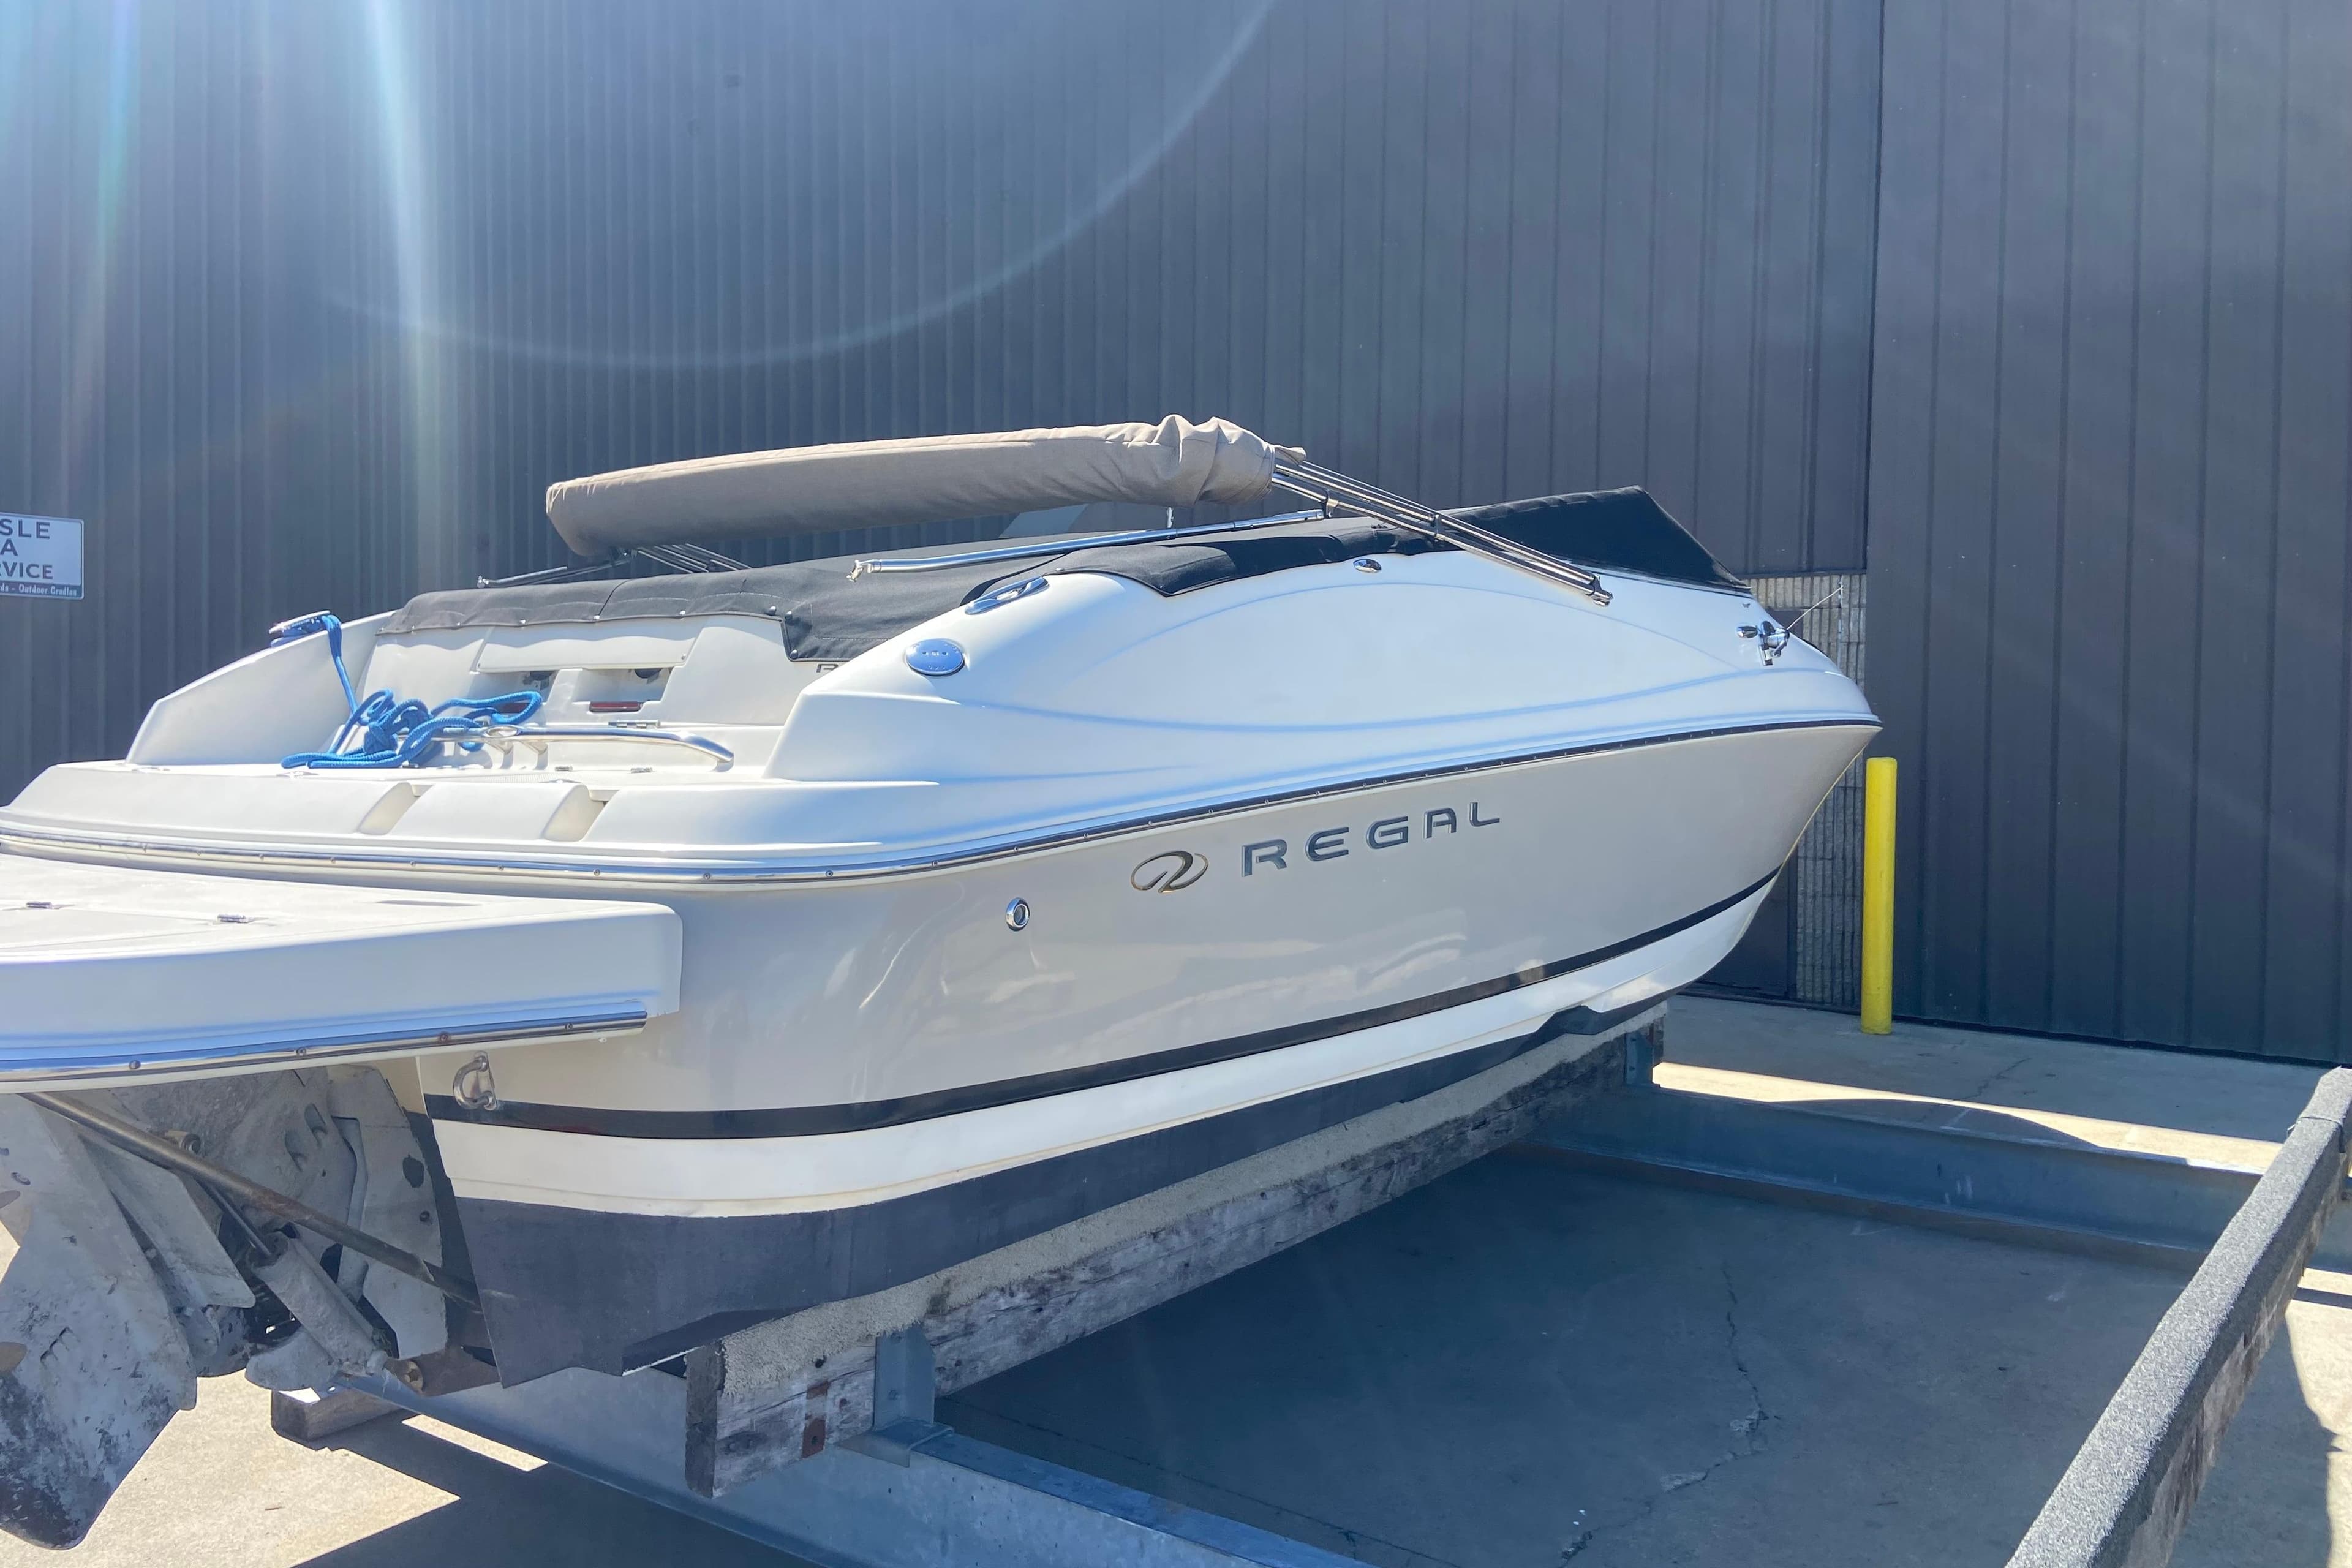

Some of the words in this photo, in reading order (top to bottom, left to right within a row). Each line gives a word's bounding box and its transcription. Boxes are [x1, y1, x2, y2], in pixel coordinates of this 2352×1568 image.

[0, 518, 50, 539] SLE
[0, 538, 18, 556] A
[0, 560, 53, 579] VICE
[18, 583, 48, 594] Outdoor
[50, 586, 77, 597] Cradles
[1241, 801, 1501, 878] REGAL
